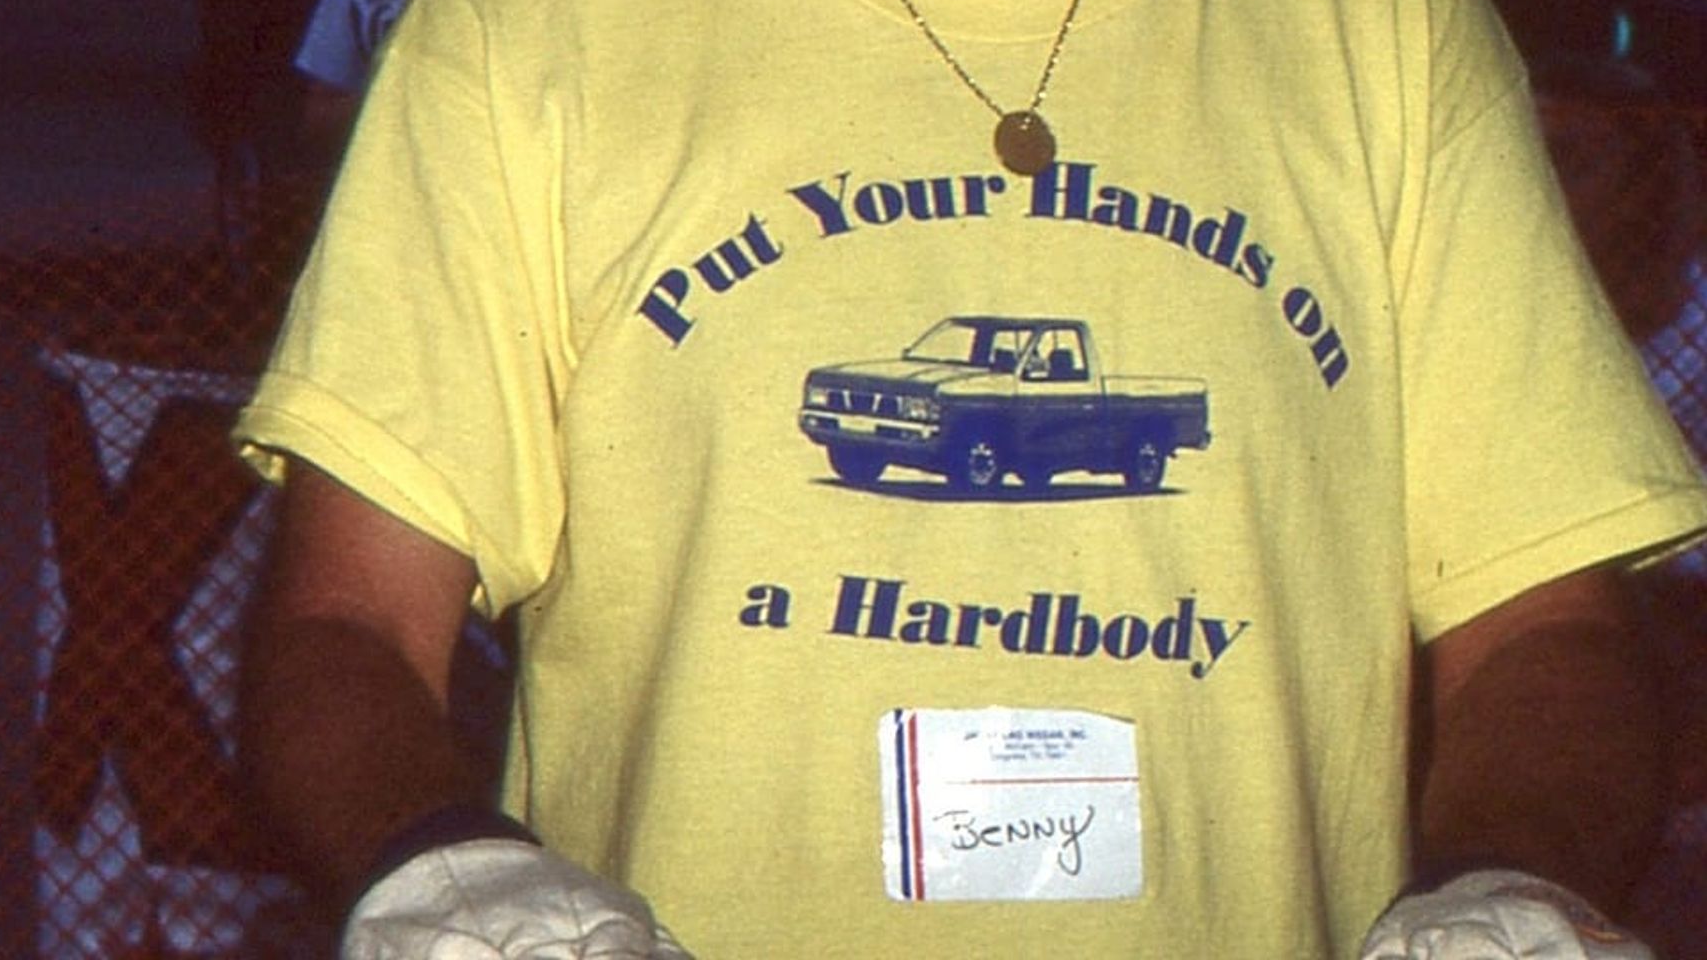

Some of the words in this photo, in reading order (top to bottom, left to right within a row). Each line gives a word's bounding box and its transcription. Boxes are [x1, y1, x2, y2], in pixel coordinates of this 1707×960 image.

[637, 210, 785, 350] Put
[786, 170, 1006, 238] Your
[1023, 160, 1276, 290] Hands
[1281, 285, 1351, 390] on
[739, 581, 791, 630] a
[824, 573, 1252, 680] Hardbody
